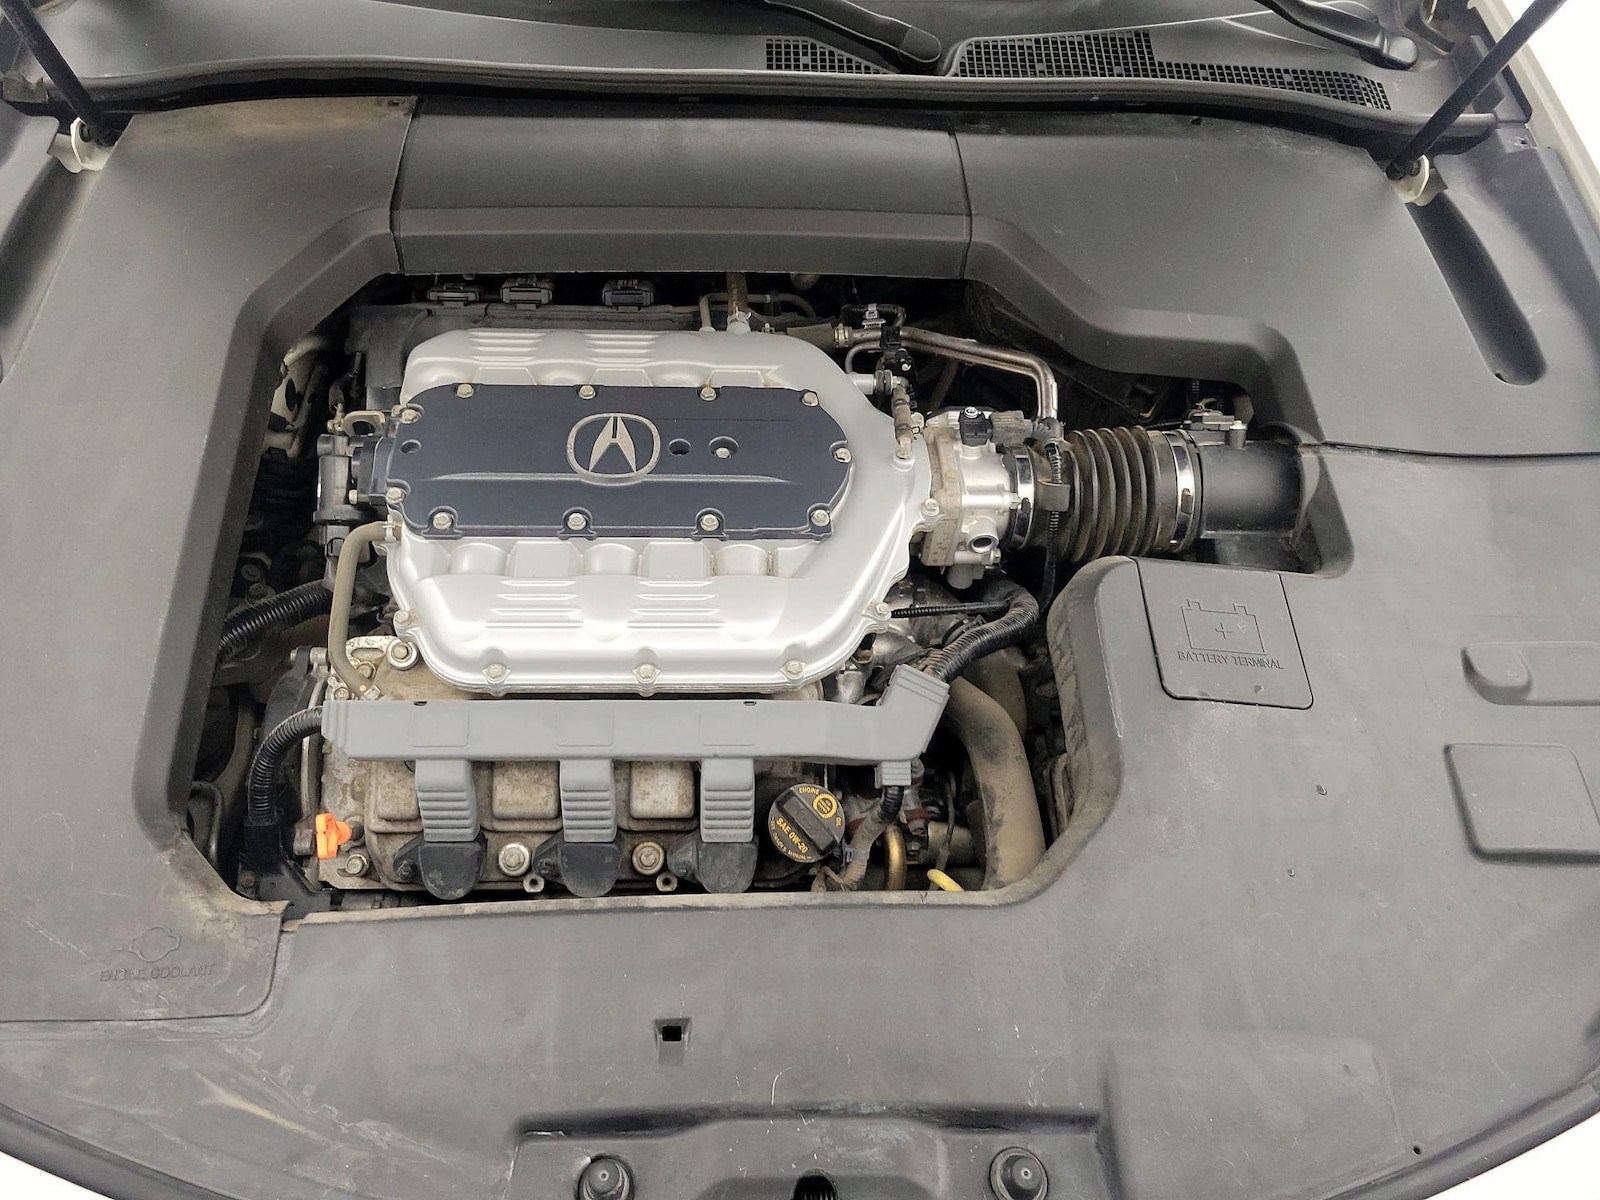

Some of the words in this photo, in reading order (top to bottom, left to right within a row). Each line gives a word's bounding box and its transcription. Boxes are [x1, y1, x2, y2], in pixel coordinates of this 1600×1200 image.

[1178, 651, 1228, 665] BATTERY
[1231, 656, 1284, 669] TERMINAL
[776, 817, 792, 834] SAE
[100, 969, 145, 982] ENGINE
[150, 964, 215, 979] COOLANT
